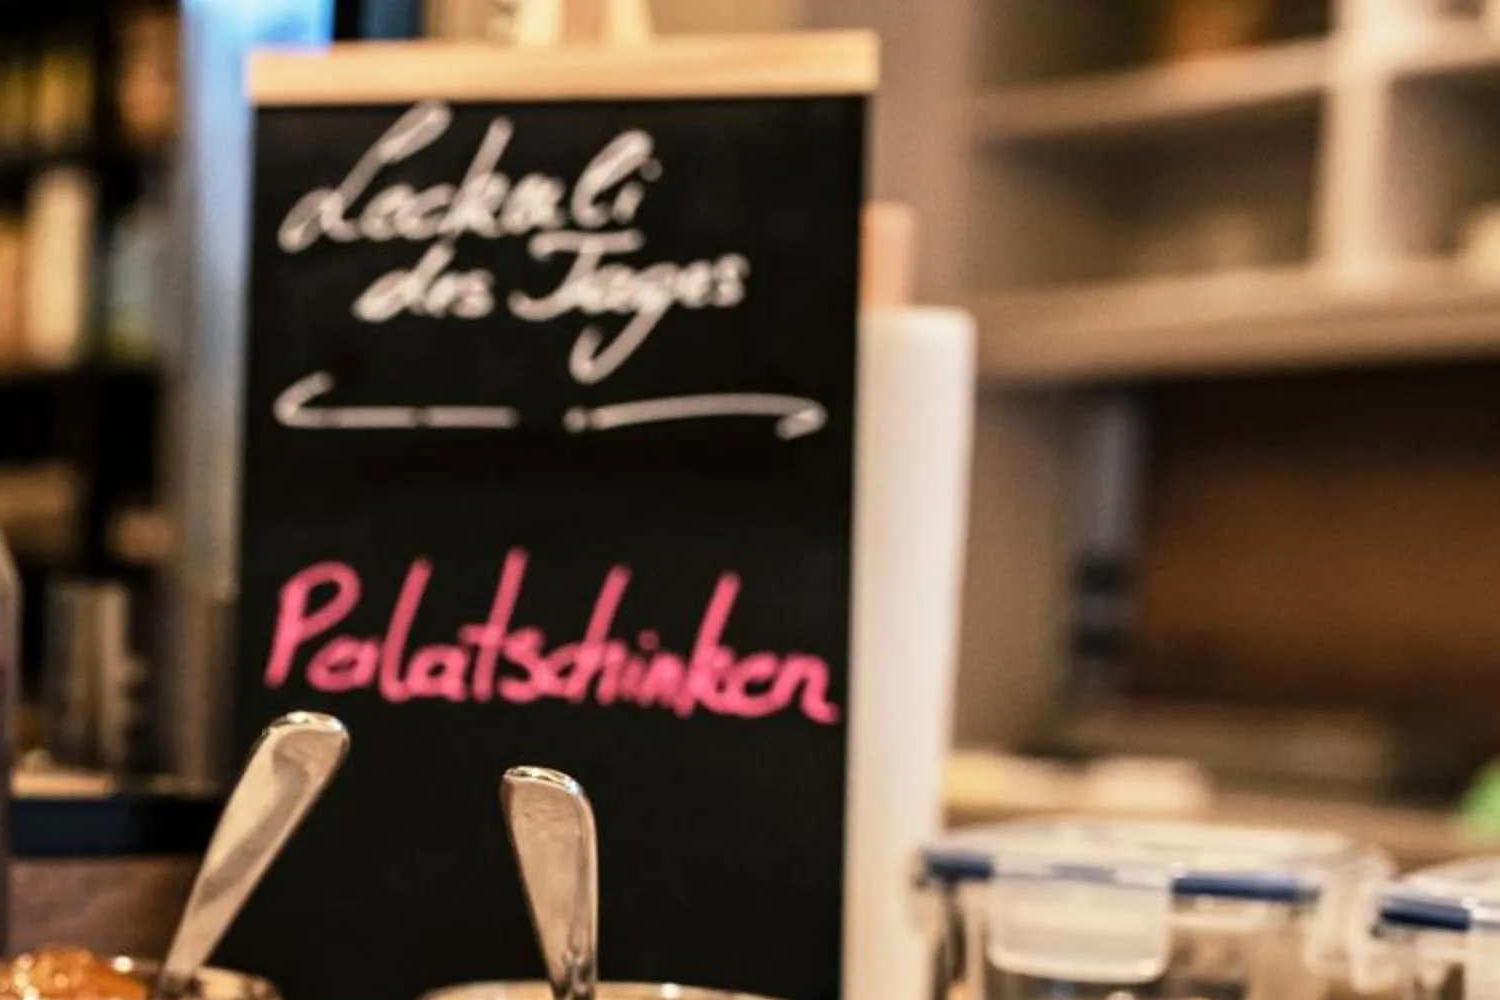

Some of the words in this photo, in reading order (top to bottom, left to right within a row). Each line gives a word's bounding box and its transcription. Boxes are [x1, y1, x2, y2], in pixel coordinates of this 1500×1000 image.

[353, 239, 495, 322] des
[508, 229, 750, 384] Tages
[265, 548, 839, 723] Palatschinken
